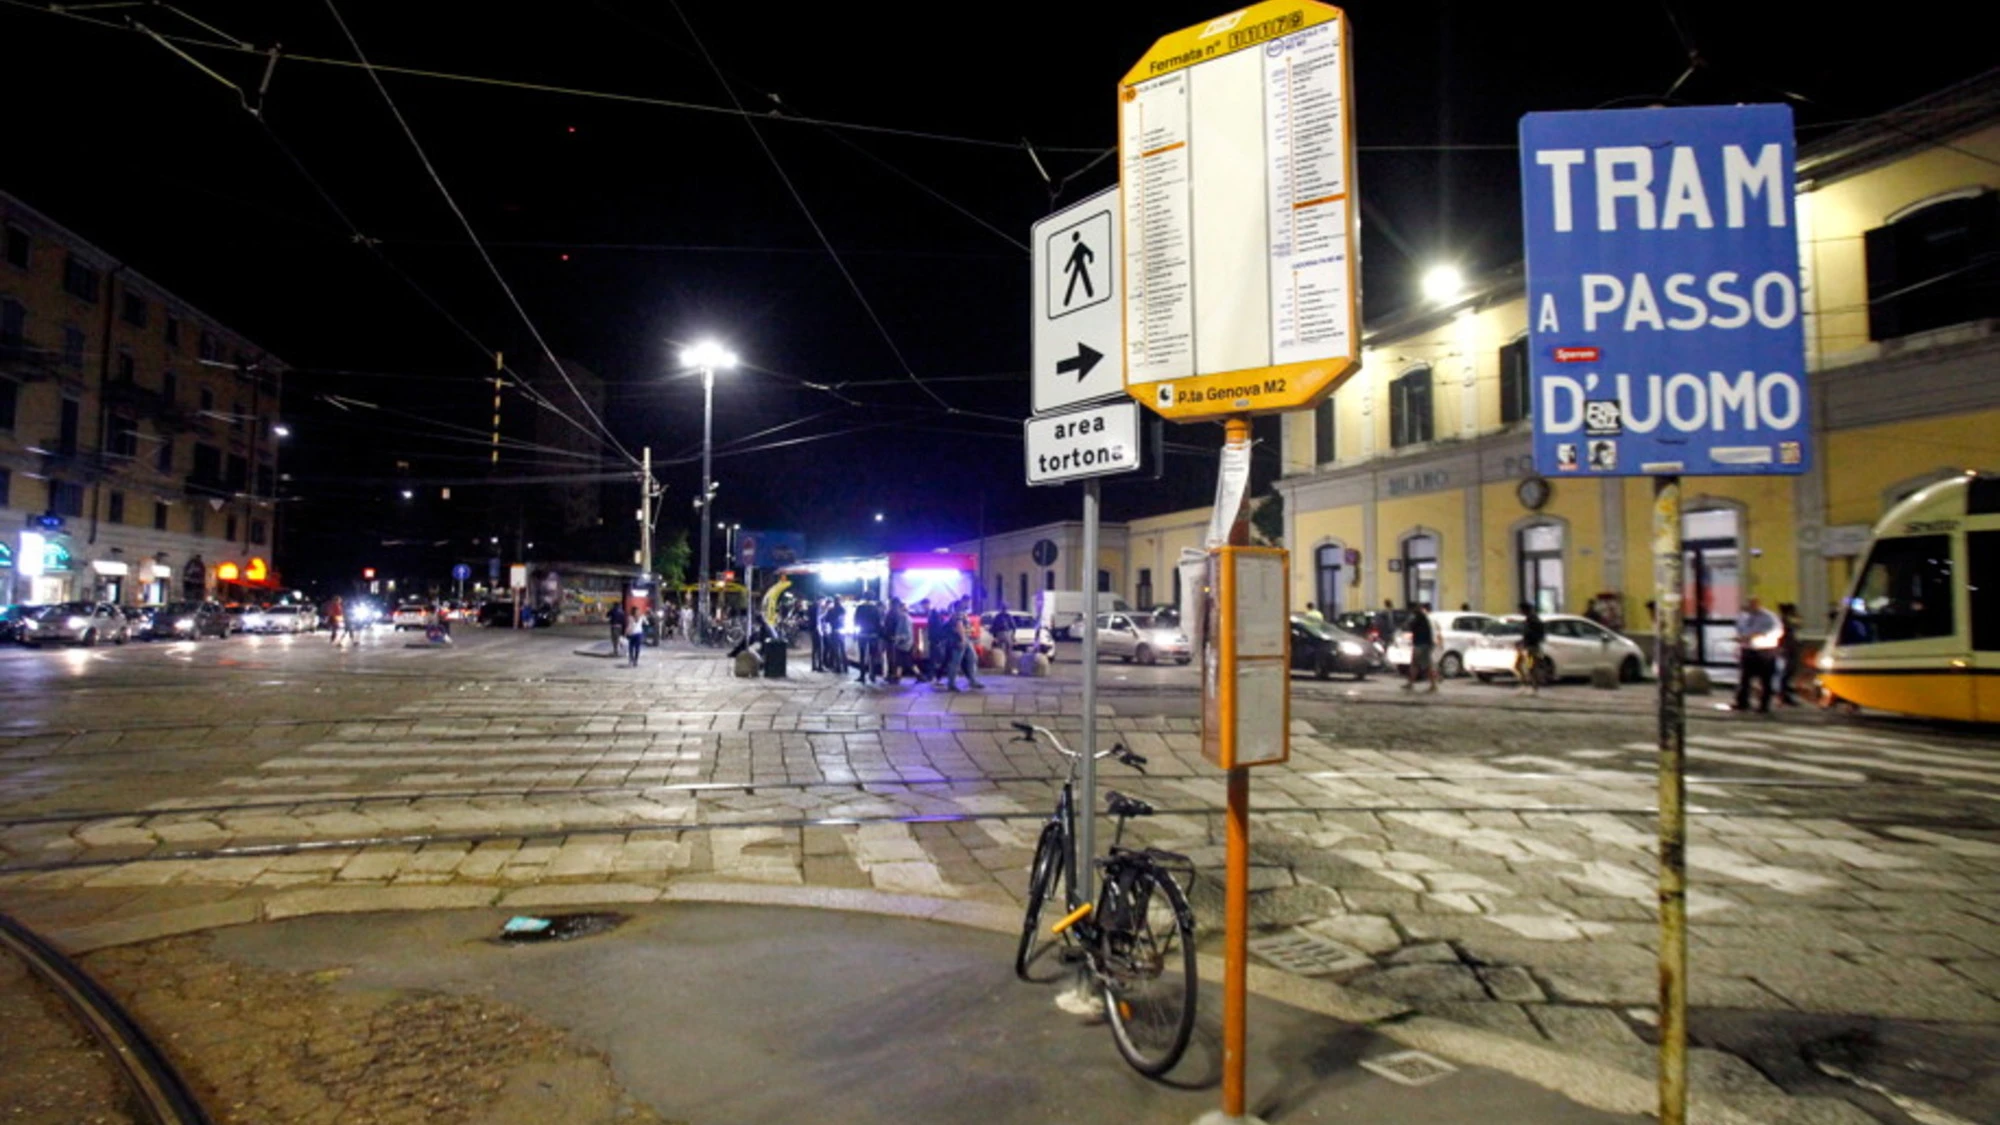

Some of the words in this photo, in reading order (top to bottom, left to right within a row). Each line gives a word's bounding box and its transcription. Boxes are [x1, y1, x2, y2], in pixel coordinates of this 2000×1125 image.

[1149, 48, 1204, 75] Fermata
[1536, 143, 1787, 232] TRAM
[1538, 293, 1560, 333] A
[1581, 271, 1797, 333] PASSO
[1178, 389, 1203, 403] P.ta
[1206, 383, 1261, 402] Genova
[1263, 379, 1287, 395] M2
[1541, 370, 1802, 434] D'UOMO
[1054, 416, 1105, 440] area
